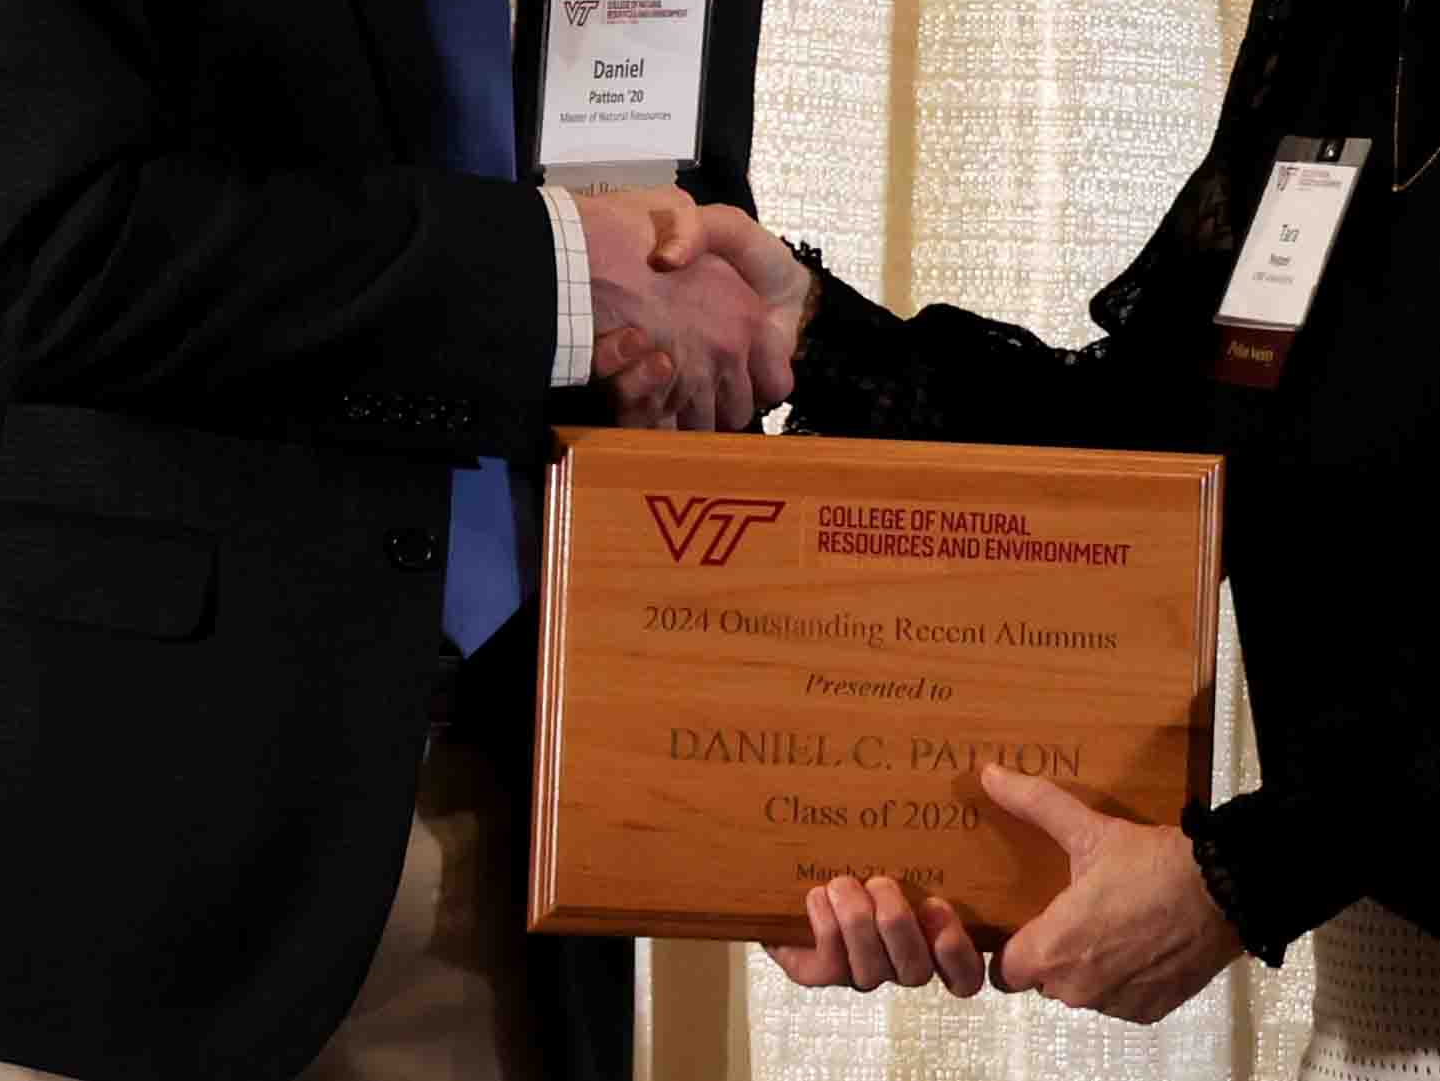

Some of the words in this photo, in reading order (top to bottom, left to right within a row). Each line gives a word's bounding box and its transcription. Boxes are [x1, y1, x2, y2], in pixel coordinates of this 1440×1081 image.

[563, 0, 600, 26] VT
[593, 57, 645, 79] Daniel
[589, 90, 624, 104] Patton
[627, 88, 645, 104] '20
[645, 495, 786, 566] VT
[818, 505, 906, 532] COLLEGE
[910, 508, 936, 532] OF
[940, 511, 1032, 537] NATURAL
[817, 531, 934, 558] RESOURCES
[937, 536, 981, 560] AND
[984, 538, 1132, 566] ENVIRONMENT
[642, 605, 709, 633] 2024
[719, 608, 884, 649] Outstanding
[894, 616, 985, 645] Recent
[994, 619, 1118, 649] Alumnus
[806, 672, 925, 701] Presented
[930, 683, 952, 702] to
[670, 728, 843, 767] DANIEL
[852, 735, 893, 770] C.
[911, 736, 1082, 777] PATTON
[764, 796, 848, 826] Class
[859, 800, 897, 828] of
[902, 801, 979, 831] 2020
